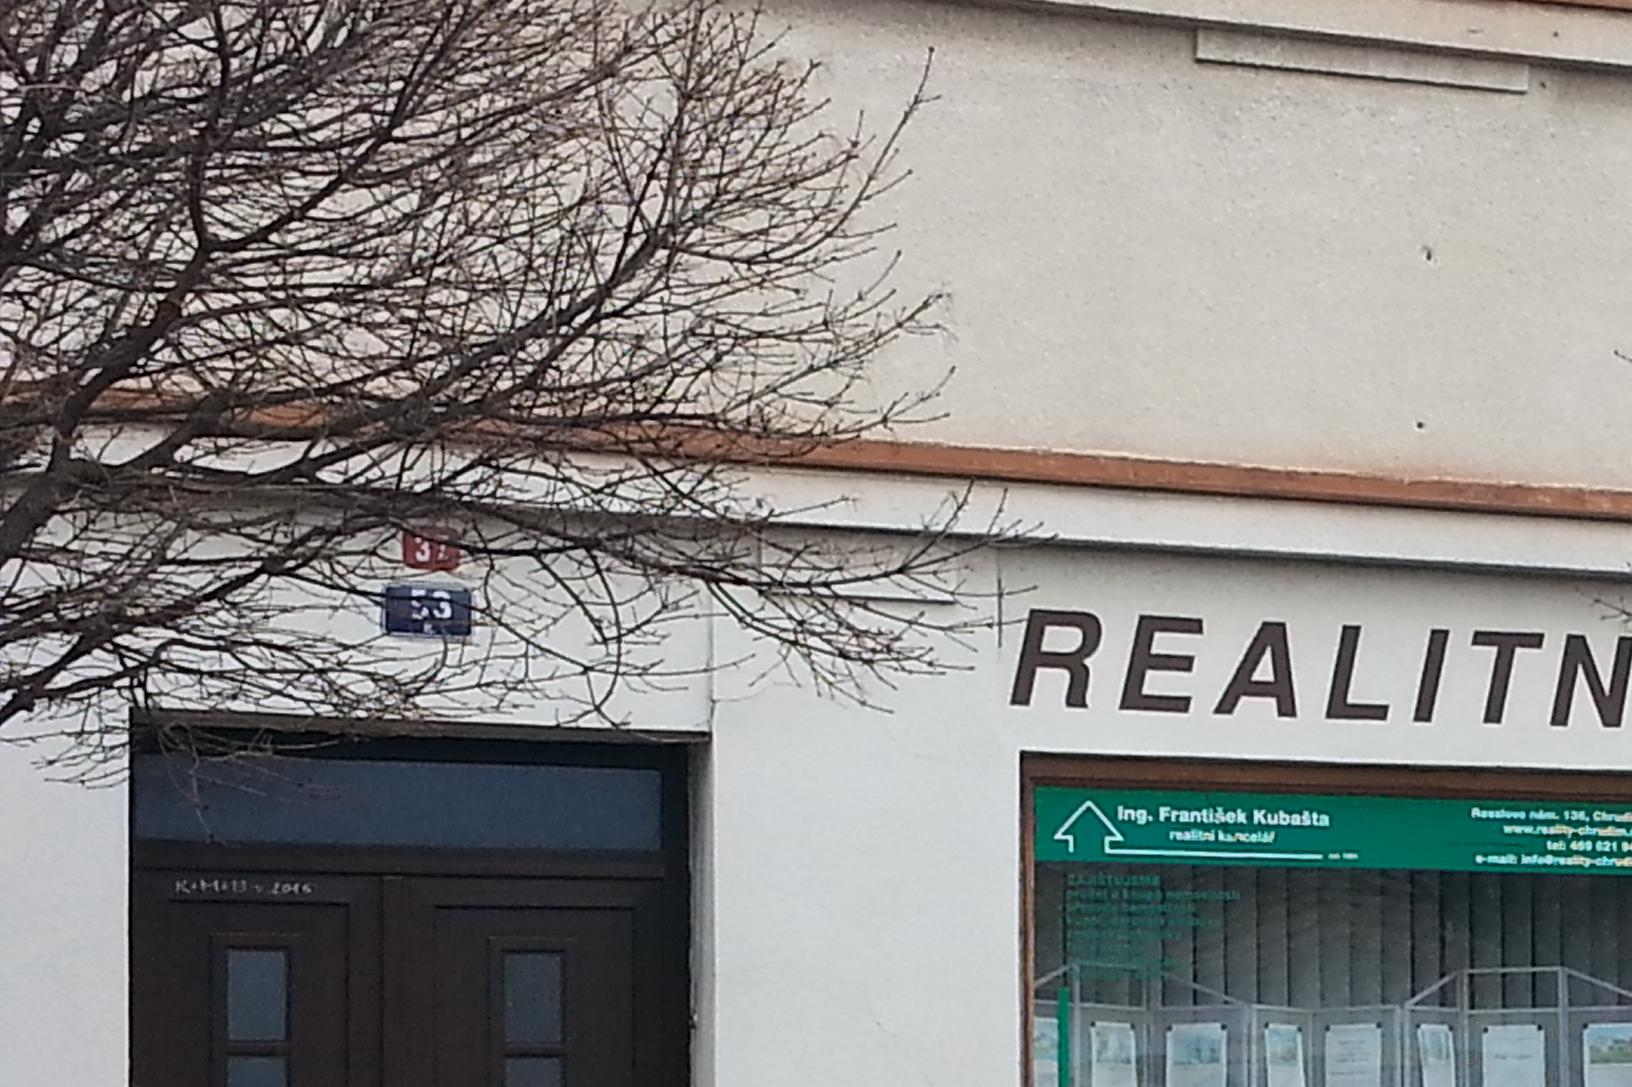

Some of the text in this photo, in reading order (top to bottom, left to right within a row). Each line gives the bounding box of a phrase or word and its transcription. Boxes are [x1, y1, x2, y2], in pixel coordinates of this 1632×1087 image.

[411, 588, 452, 619] 53
[1117, 804, 1330, 827] Ing. František Kubašta
[1169, 830, 1275, 844] realitní kancelář
